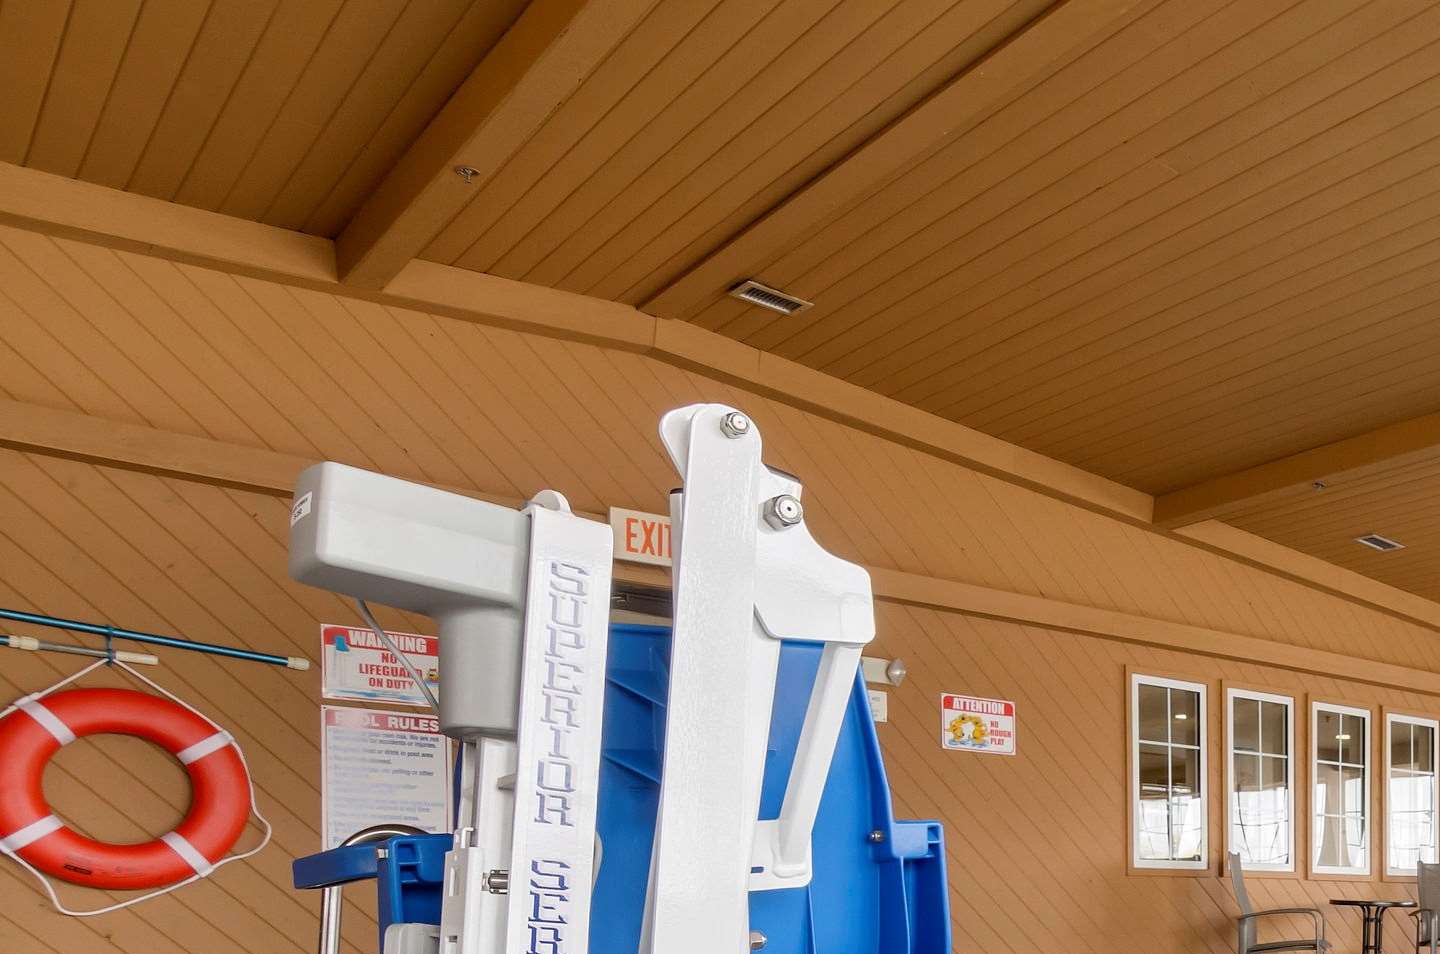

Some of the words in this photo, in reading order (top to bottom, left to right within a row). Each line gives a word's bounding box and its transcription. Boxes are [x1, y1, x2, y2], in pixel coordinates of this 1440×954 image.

[625, 517, 672, 558] EXIT
[381, 653, 398, 664] NO
[359, 664, 423, 678] LIFEGUAD
[368, 677, 384, 687] ON
[386, 678, 414, 689] DUTY
[534, 561, 590, 828] SUPERIOR
[953, 697, 1005, 714] ATTENTION
[388, 716, 440, 732] RULES
